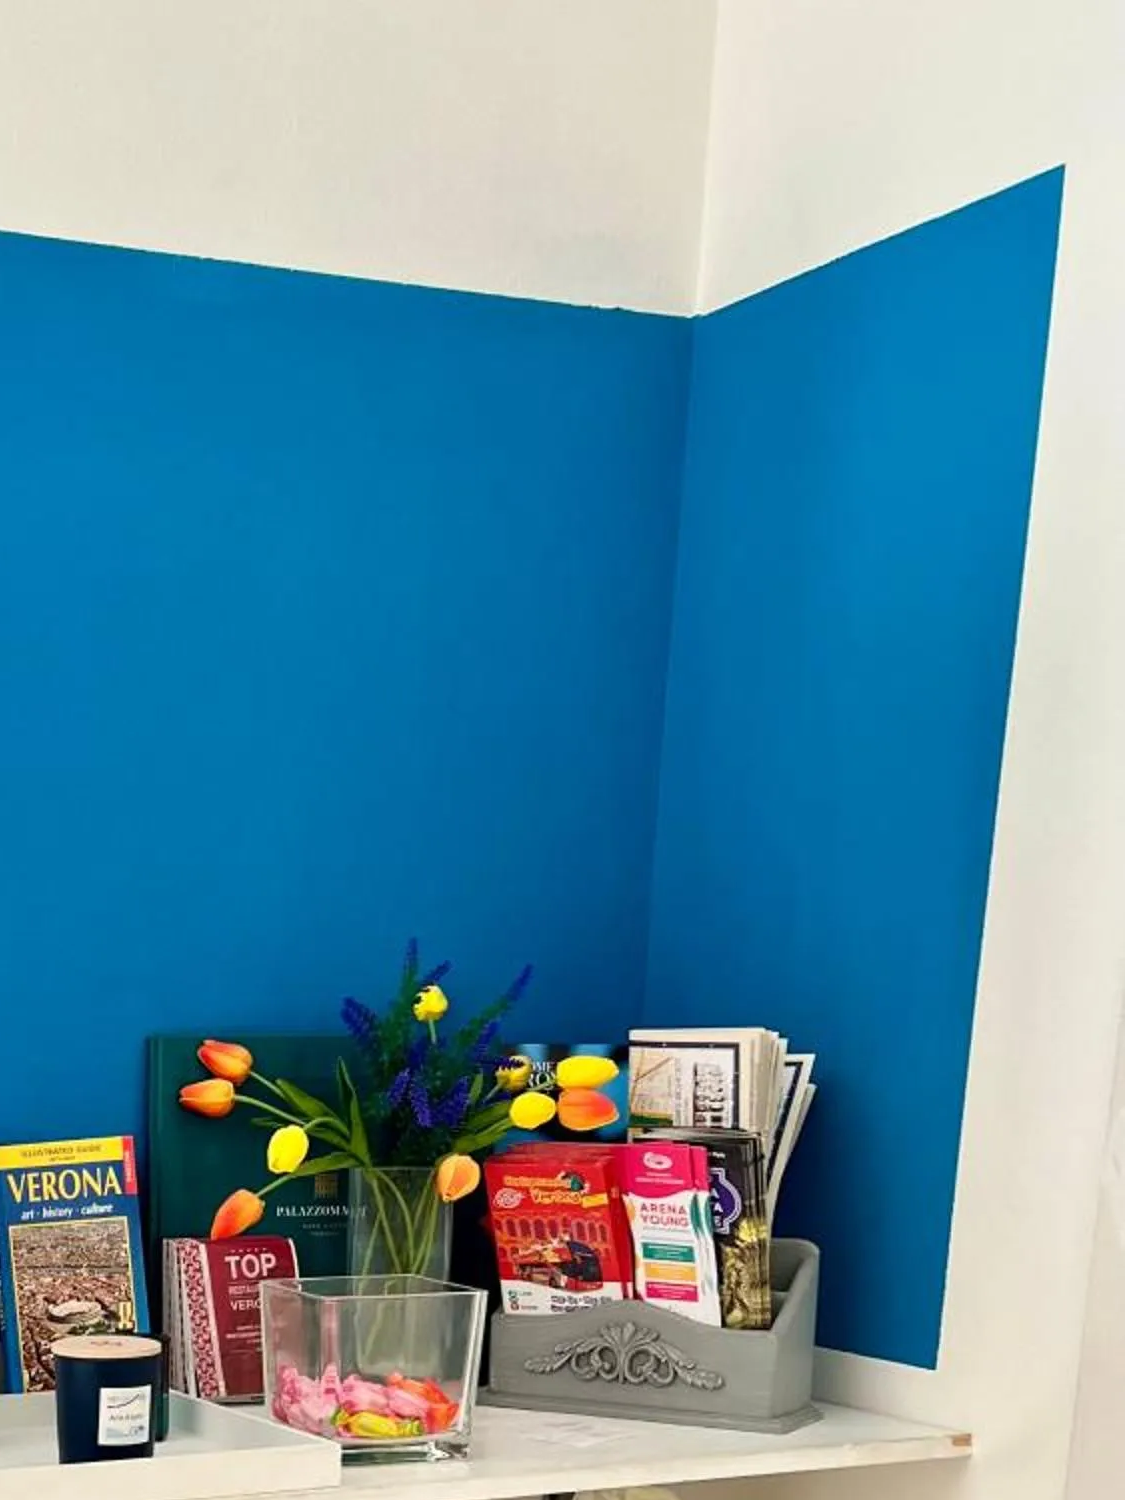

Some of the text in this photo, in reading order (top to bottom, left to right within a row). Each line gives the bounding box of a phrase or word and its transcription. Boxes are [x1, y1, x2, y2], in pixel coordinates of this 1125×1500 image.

[6, 1165, 124, 1205] VERONA
[20, 1201, 115, 1221] art history culture
[639, 1202, 688, 1215] ARENA
[641, 1214, 690, 1227] YOUNG
[223, 1253, 277, 1279] TOP
